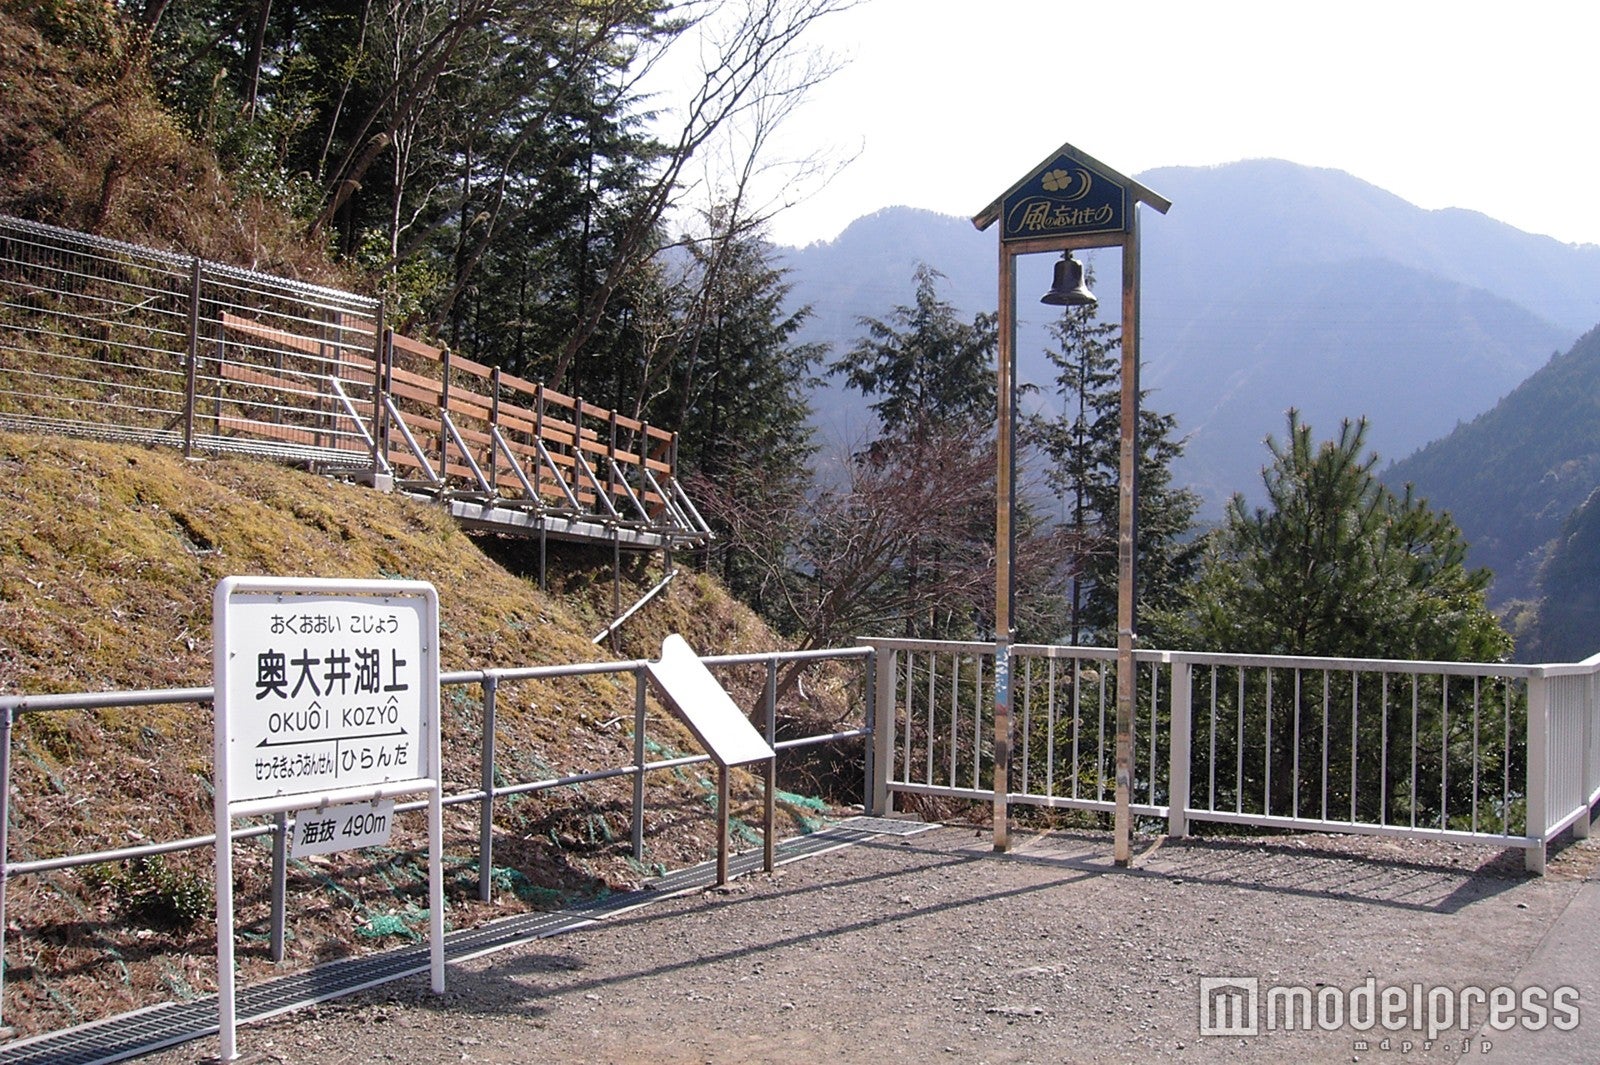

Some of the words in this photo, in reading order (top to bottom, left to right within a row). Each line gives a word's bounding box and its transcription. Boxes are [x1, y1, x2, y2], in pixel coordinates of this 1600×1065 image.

[1008, 200, 1113, 232] 風の忘れもの
[270, 614, 341, 635] おくおおい
[350, 614, 399, 634] こじょう
[256, 648, 408, 700] 奥大井湖上
[268, 701, 329, 733] OKUÔI
[342, 695, 399, 728] KOZYÔ
[341, 742, 409, 771] ひらんだ
[301, 819, 336, 845] 海抜
[342, 813, 386, 837] 490m
